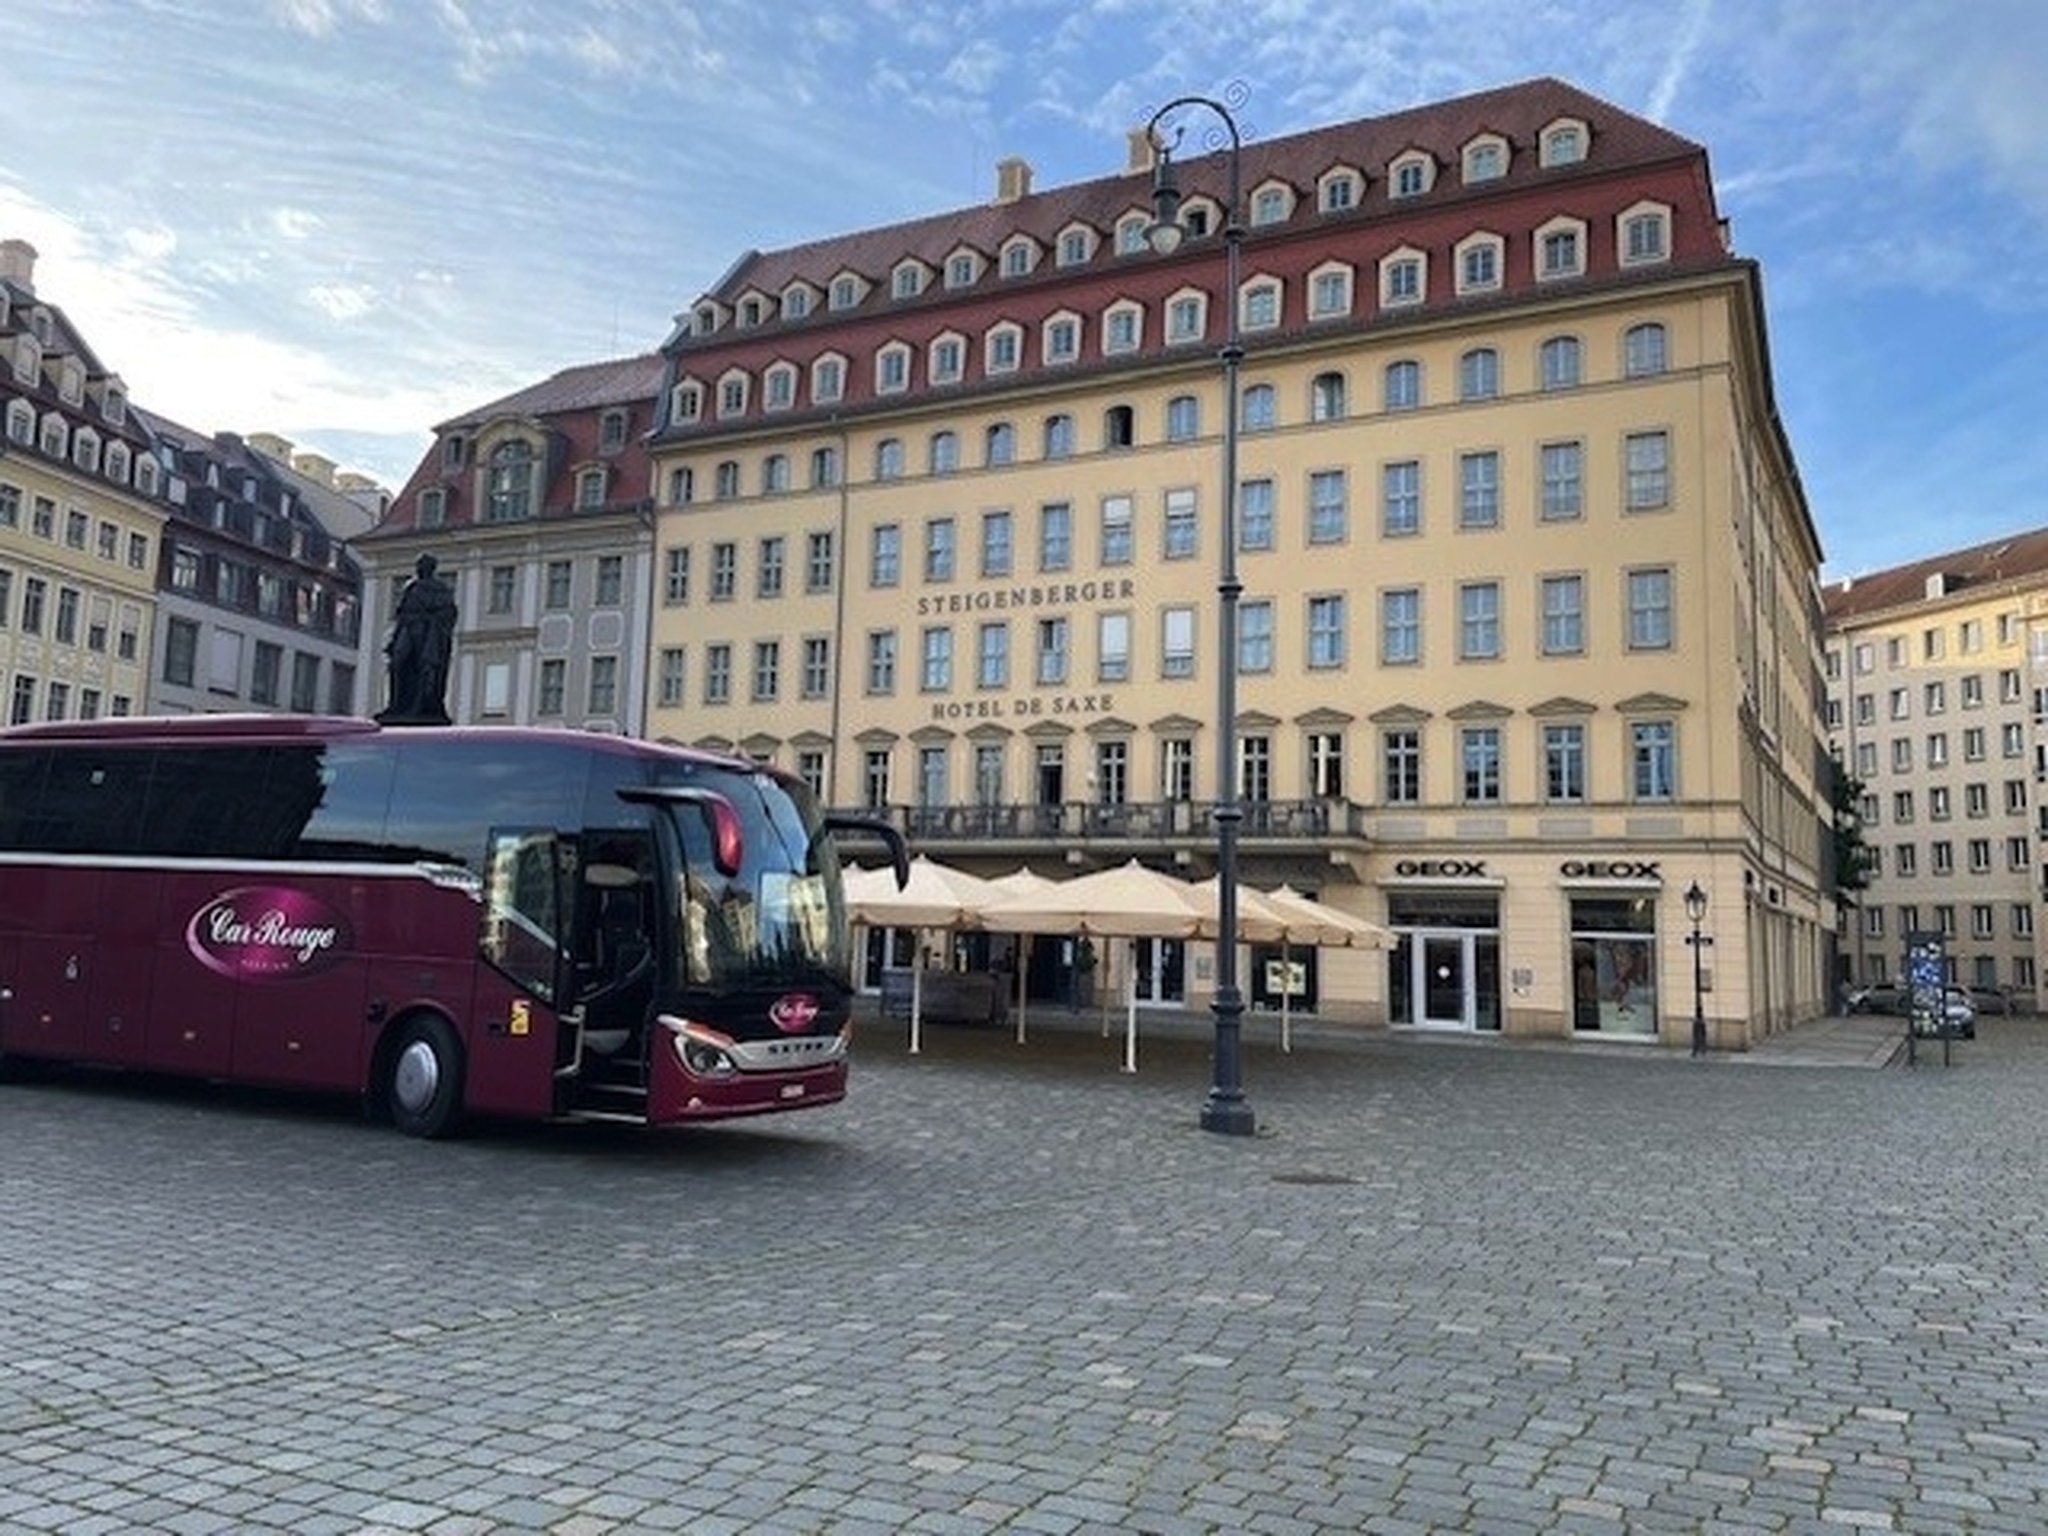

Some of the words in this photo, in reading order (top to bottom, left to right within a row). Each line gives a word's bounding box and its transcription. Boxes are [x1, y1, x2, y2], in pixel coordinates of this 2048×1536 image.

[917, 579, 1135, 615] STEIGENBERGER
[932, 700, 1004, 720] HOTEL
[1014, 697, 1043, 715] DE
[1053, 694, 1114, 714] SAXE
[1395, 860, 1487, 878] GEOX
[1560, 861, 1661, 878] GEOX
[210, 906, 252, 944] Car
[254, 909, 337, 963] Rouge
